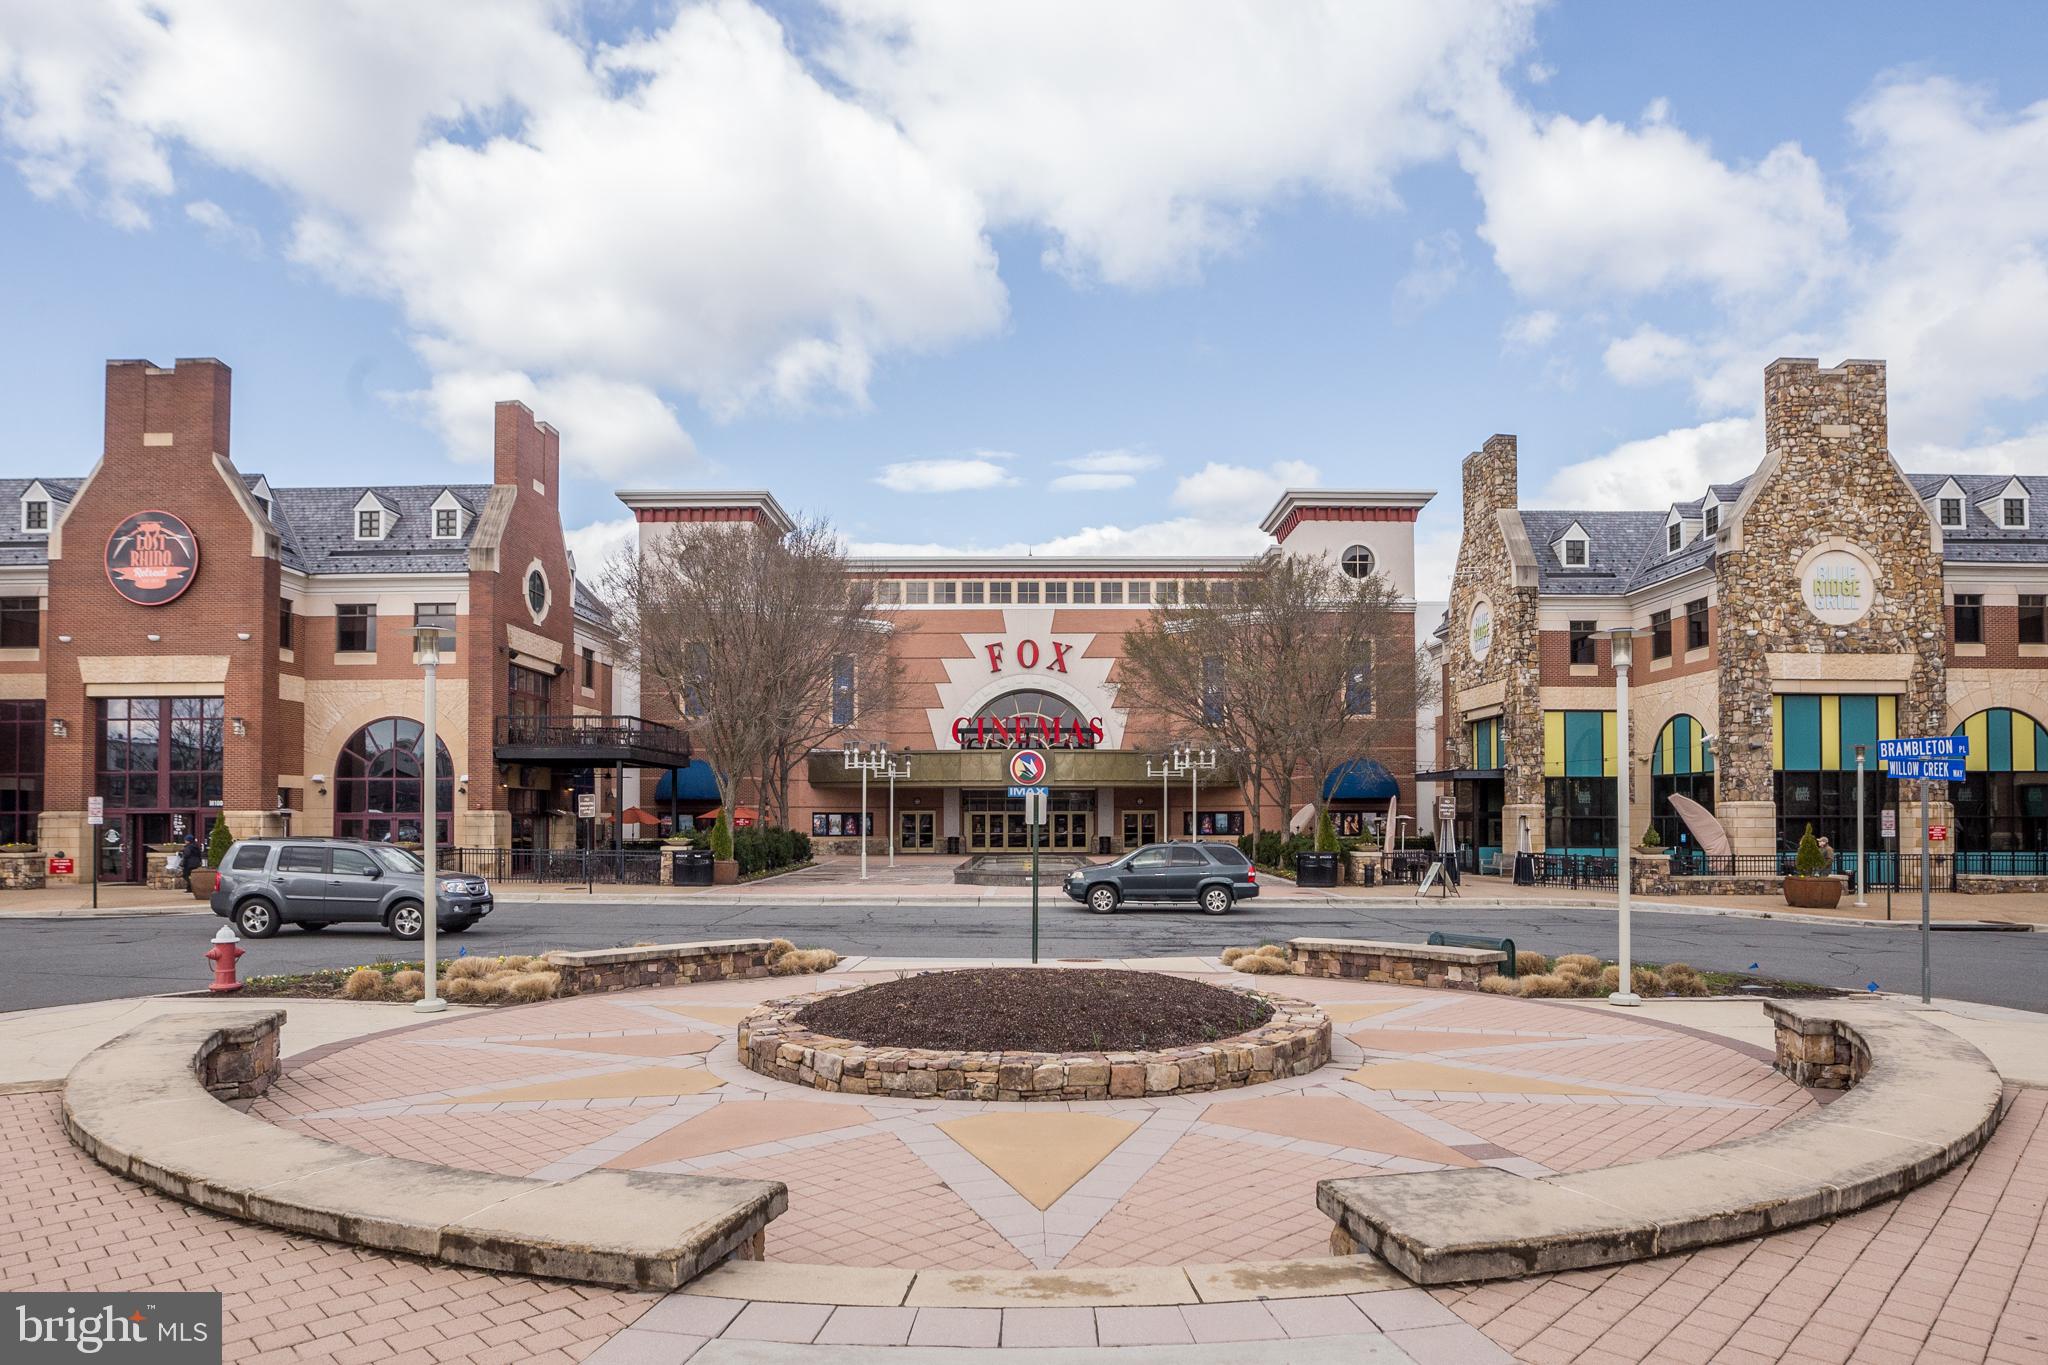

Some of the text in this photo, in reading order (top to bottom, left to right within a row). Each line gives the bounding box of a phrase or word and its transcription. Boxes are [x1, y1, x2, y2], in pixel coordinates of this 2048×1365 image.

[136, 534, 166, 550] LOST
[1816, 565, 1857, 580] BLUE
[1813, 579, 1861, 597] RIDGE
[1815, 596, 1859, 610] GRILL
[984, 639, 1073, 674] FOX
[951, 716, 1105, 745] CINEMAS
[1880, 739, 1967, 757] BRAMBLETON PL
[1889, 760, 1964, 778] WILLOW CREEK WAY
[1009, 787, 1046, 796] IMAX
